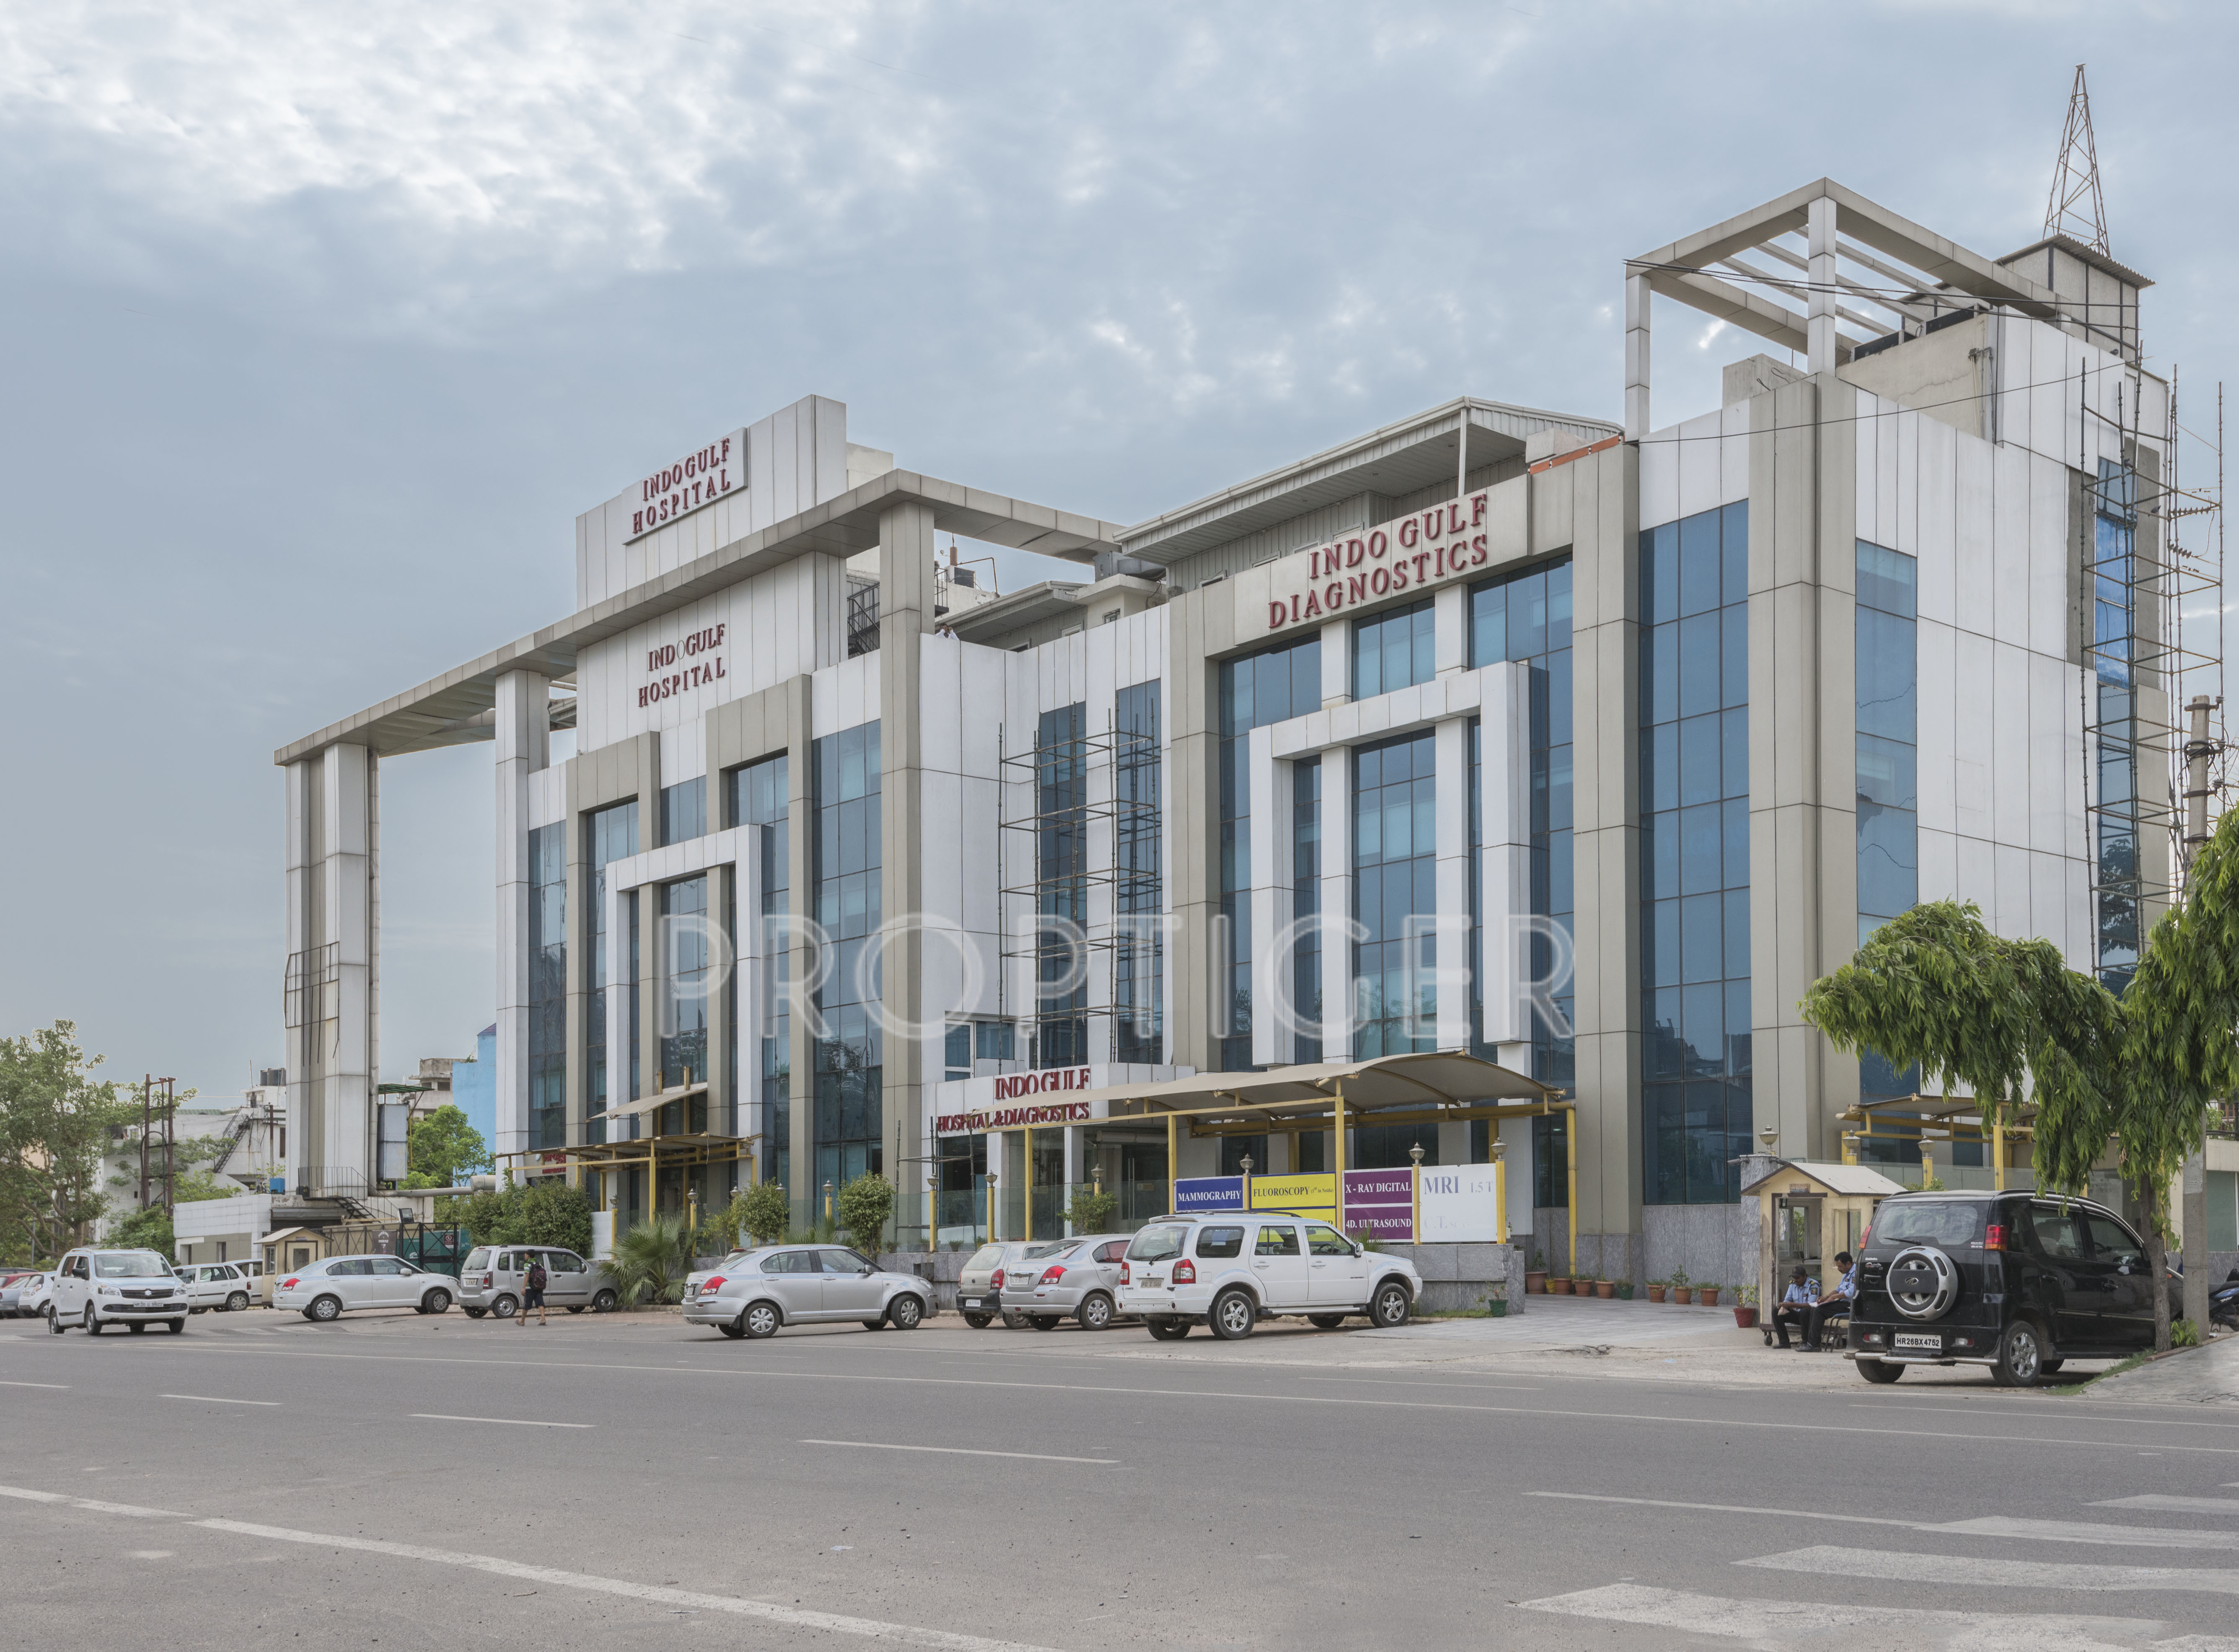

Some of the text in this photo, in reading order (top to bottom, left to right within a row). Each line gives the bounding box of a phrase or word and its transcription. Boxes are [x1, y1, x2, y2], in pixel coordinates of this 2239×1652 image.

[632, 469, 730, 534] HOSPITAL
[1309, 494, 1487, 580] INDO GULF
[1268, 533, 1486, 629] DIAGNOSTICS
[637, 657, 726, 707] HOSPITAL
[995, 1068, 1090, 1100] INDO GULF
[1253, 1186, 1310, 1197] FLUOROSCOPY
[1346, 1185, 1351, 1193] X
[1358, 1183, 1374, 1193] RAY
[1376, 1182, 1411, 1192] DIGITAL
[1424, 1176, 1460, 1194] MRI
[1178, 1190, 1241, 1202] MAMMOGRAPHY
[1359, 1218, 1412, 1228] ULTRASOUND
[1896, 1337, 1939, 1347] HR26BX4752
